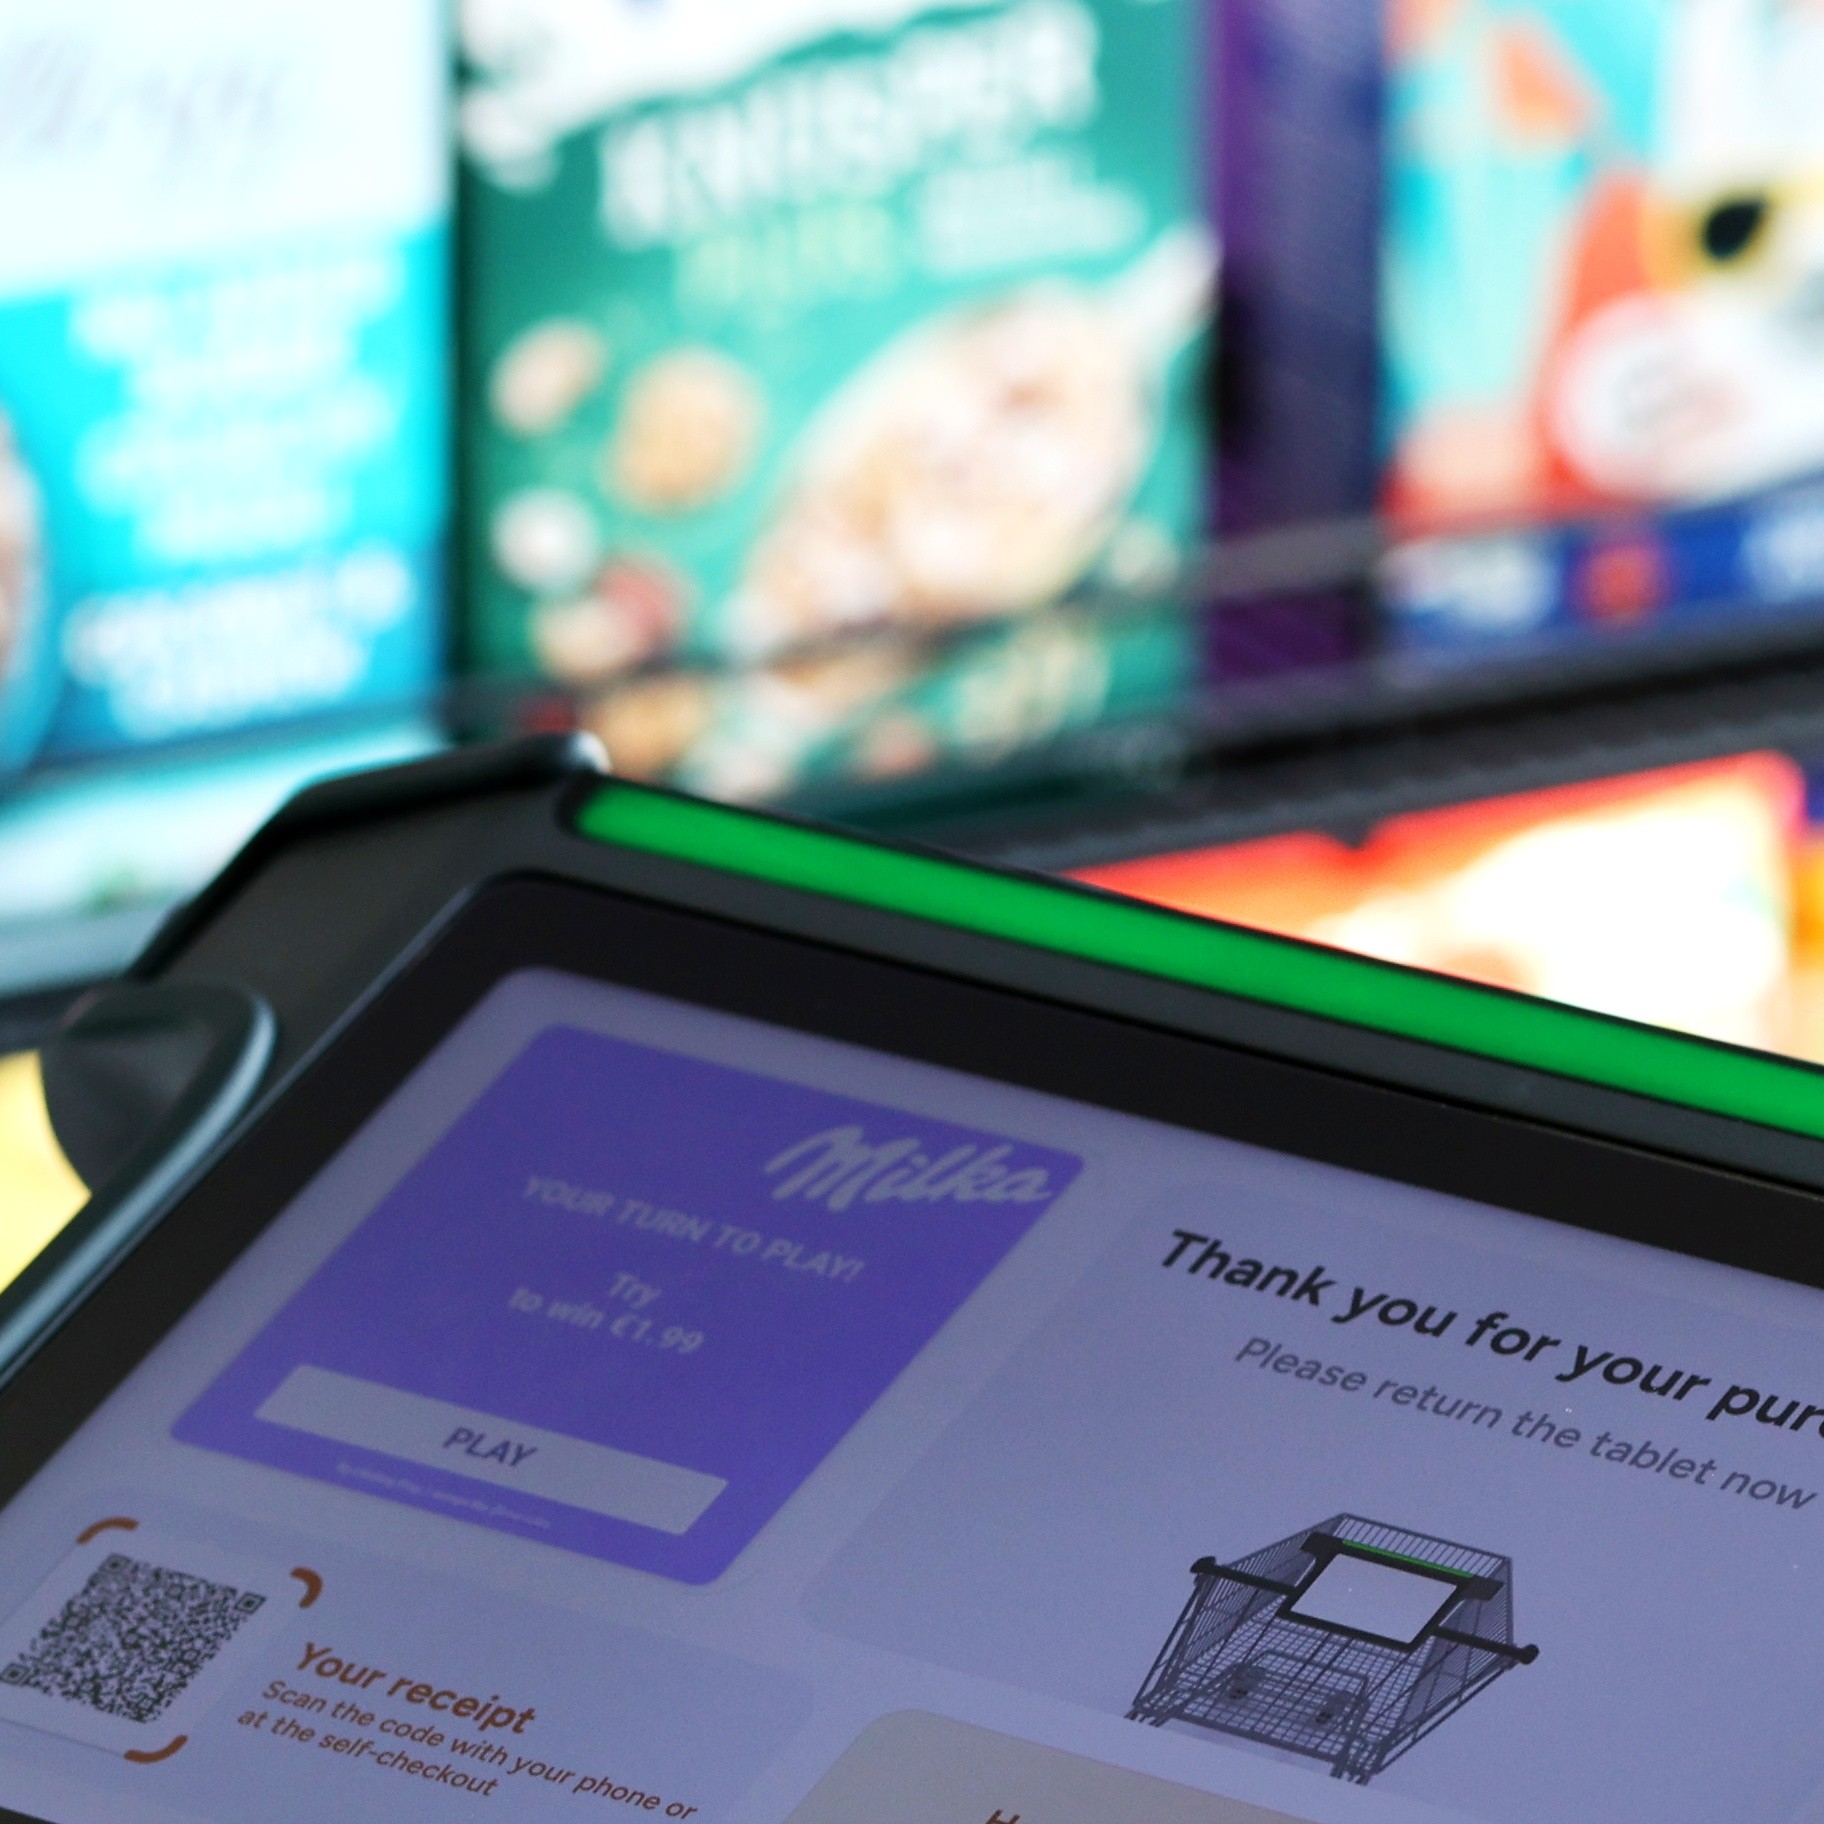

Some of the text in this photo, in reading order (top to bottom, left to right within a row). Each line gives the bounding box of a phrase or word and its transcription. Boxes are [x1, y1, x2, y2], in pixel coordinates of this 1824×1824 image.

[763, 1126, 1053, 1212] Milka
[523, 1175, 866, 1283] YOUR TURN TO PLAY!
[509, 1287, 705, 1354] to win €1.99
[608, 1272, 663, 1309] Try
[1160, 1228, 1337, 1307] Thank
[1331, 1286, 1459, 1338] you
[1464, 1311, 1562, 1363] for
[1554, 1344, 1712, 1402] your
[441, 1426, 539, 1468] PLAY
[1234, 1336, 1819, 1511] Please return the tablet now
[296, 1641, 536, 1734] Your receipt
[237, 1710, 499, 1796] at the self-checkout
[261, 1679, 698, 1820] Scan the code with your phone or
